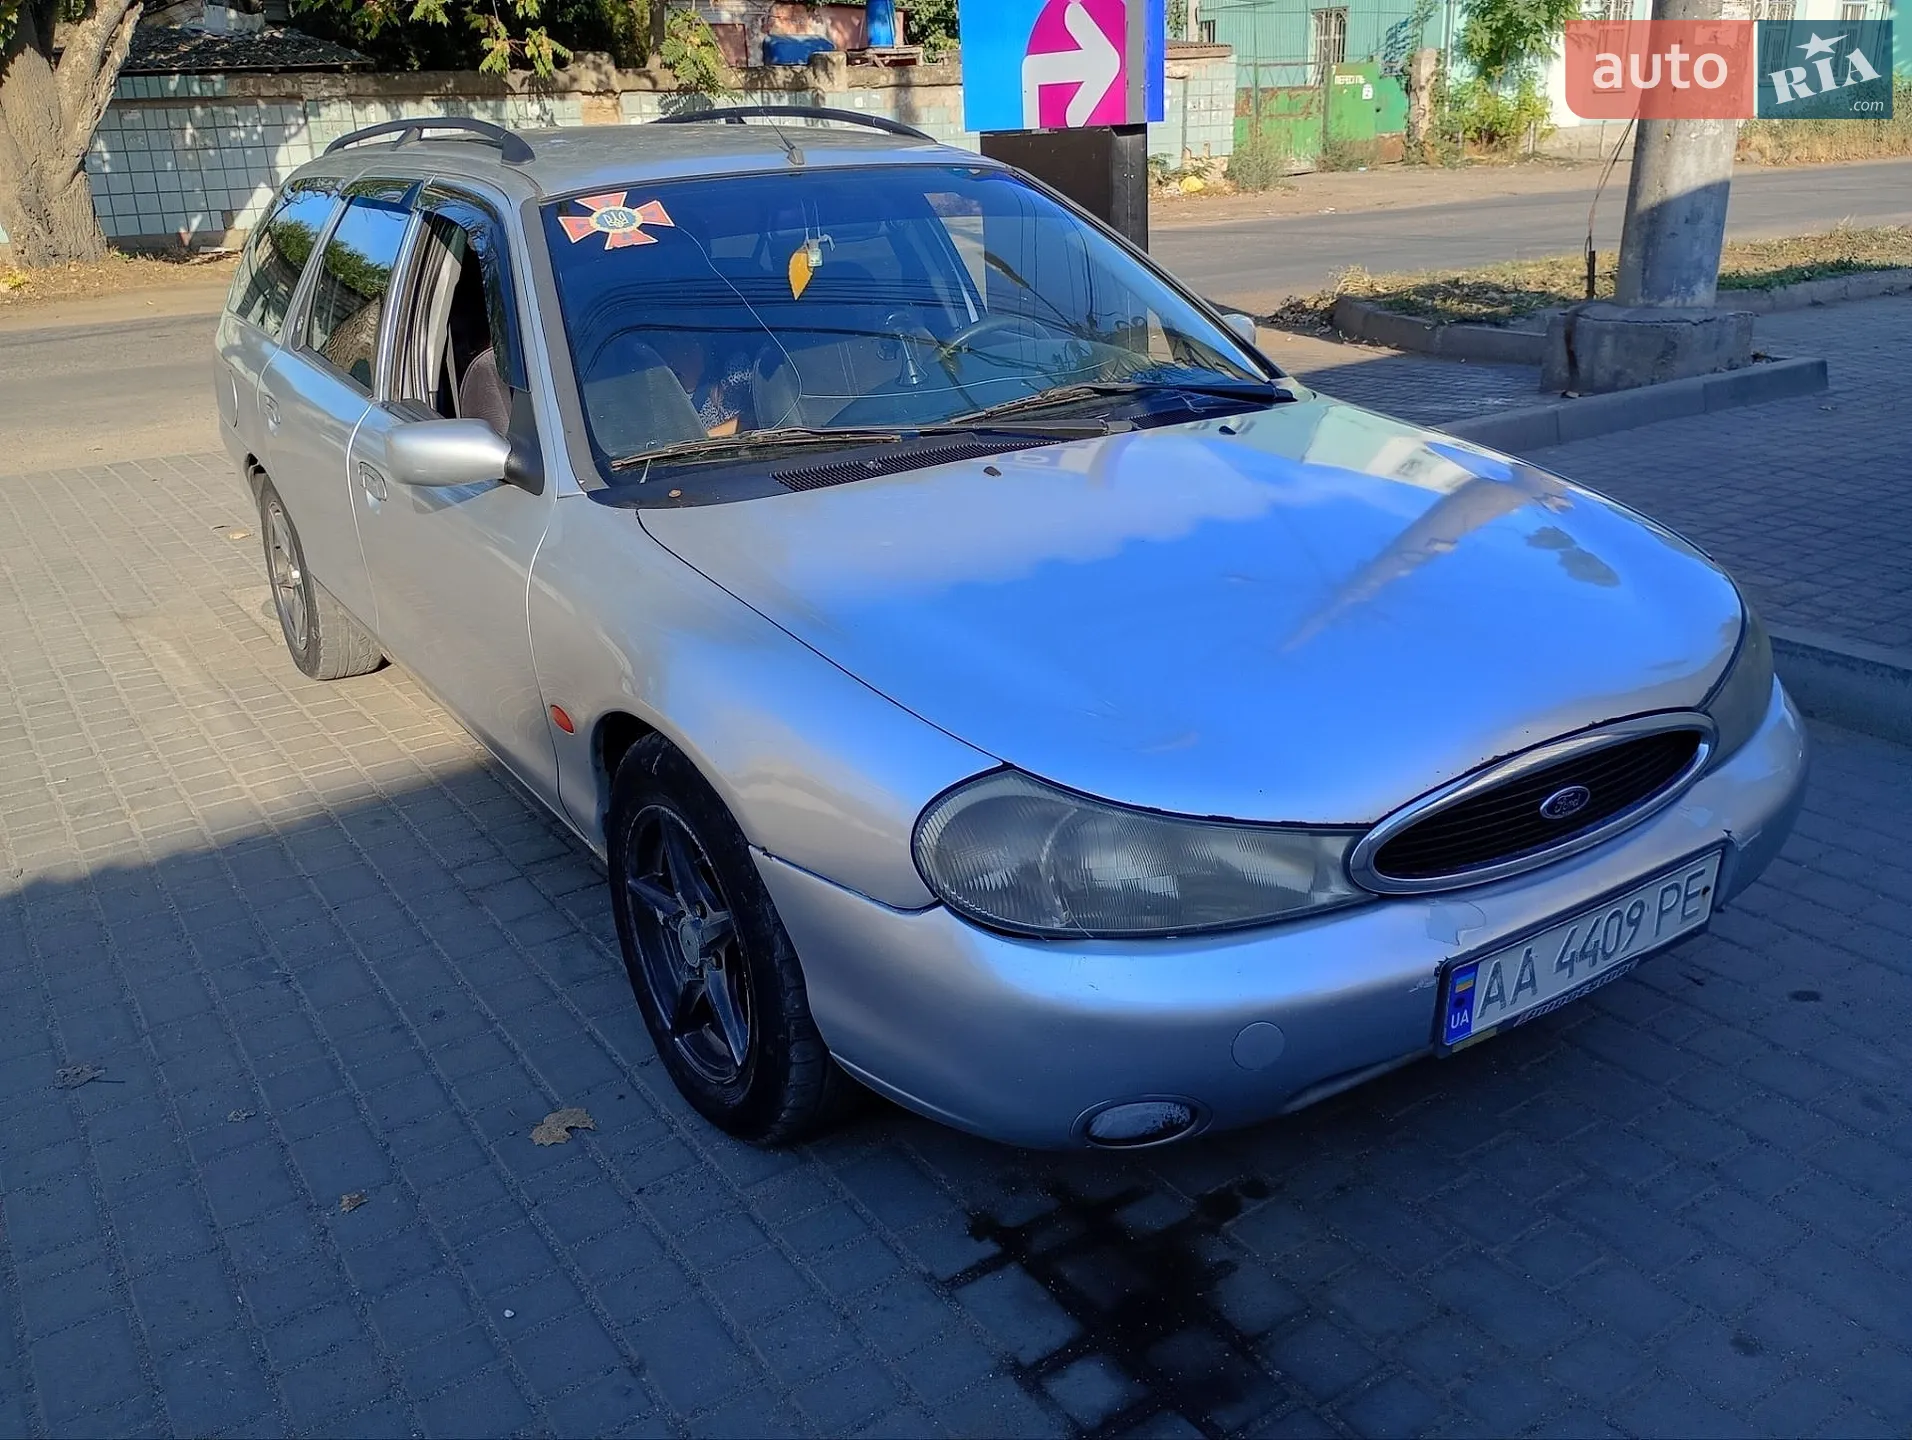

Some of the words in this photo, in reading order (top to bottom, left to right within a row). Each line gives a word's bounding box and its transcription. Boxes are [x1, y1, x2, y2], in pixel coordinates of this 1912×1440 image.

[1476, 946, 1538, 1019] AA
[1553, 898, 1646, 980] 4409
[1654, 866, 1706, 938] PE
[1450, 1008, 1469, 1029] UA
